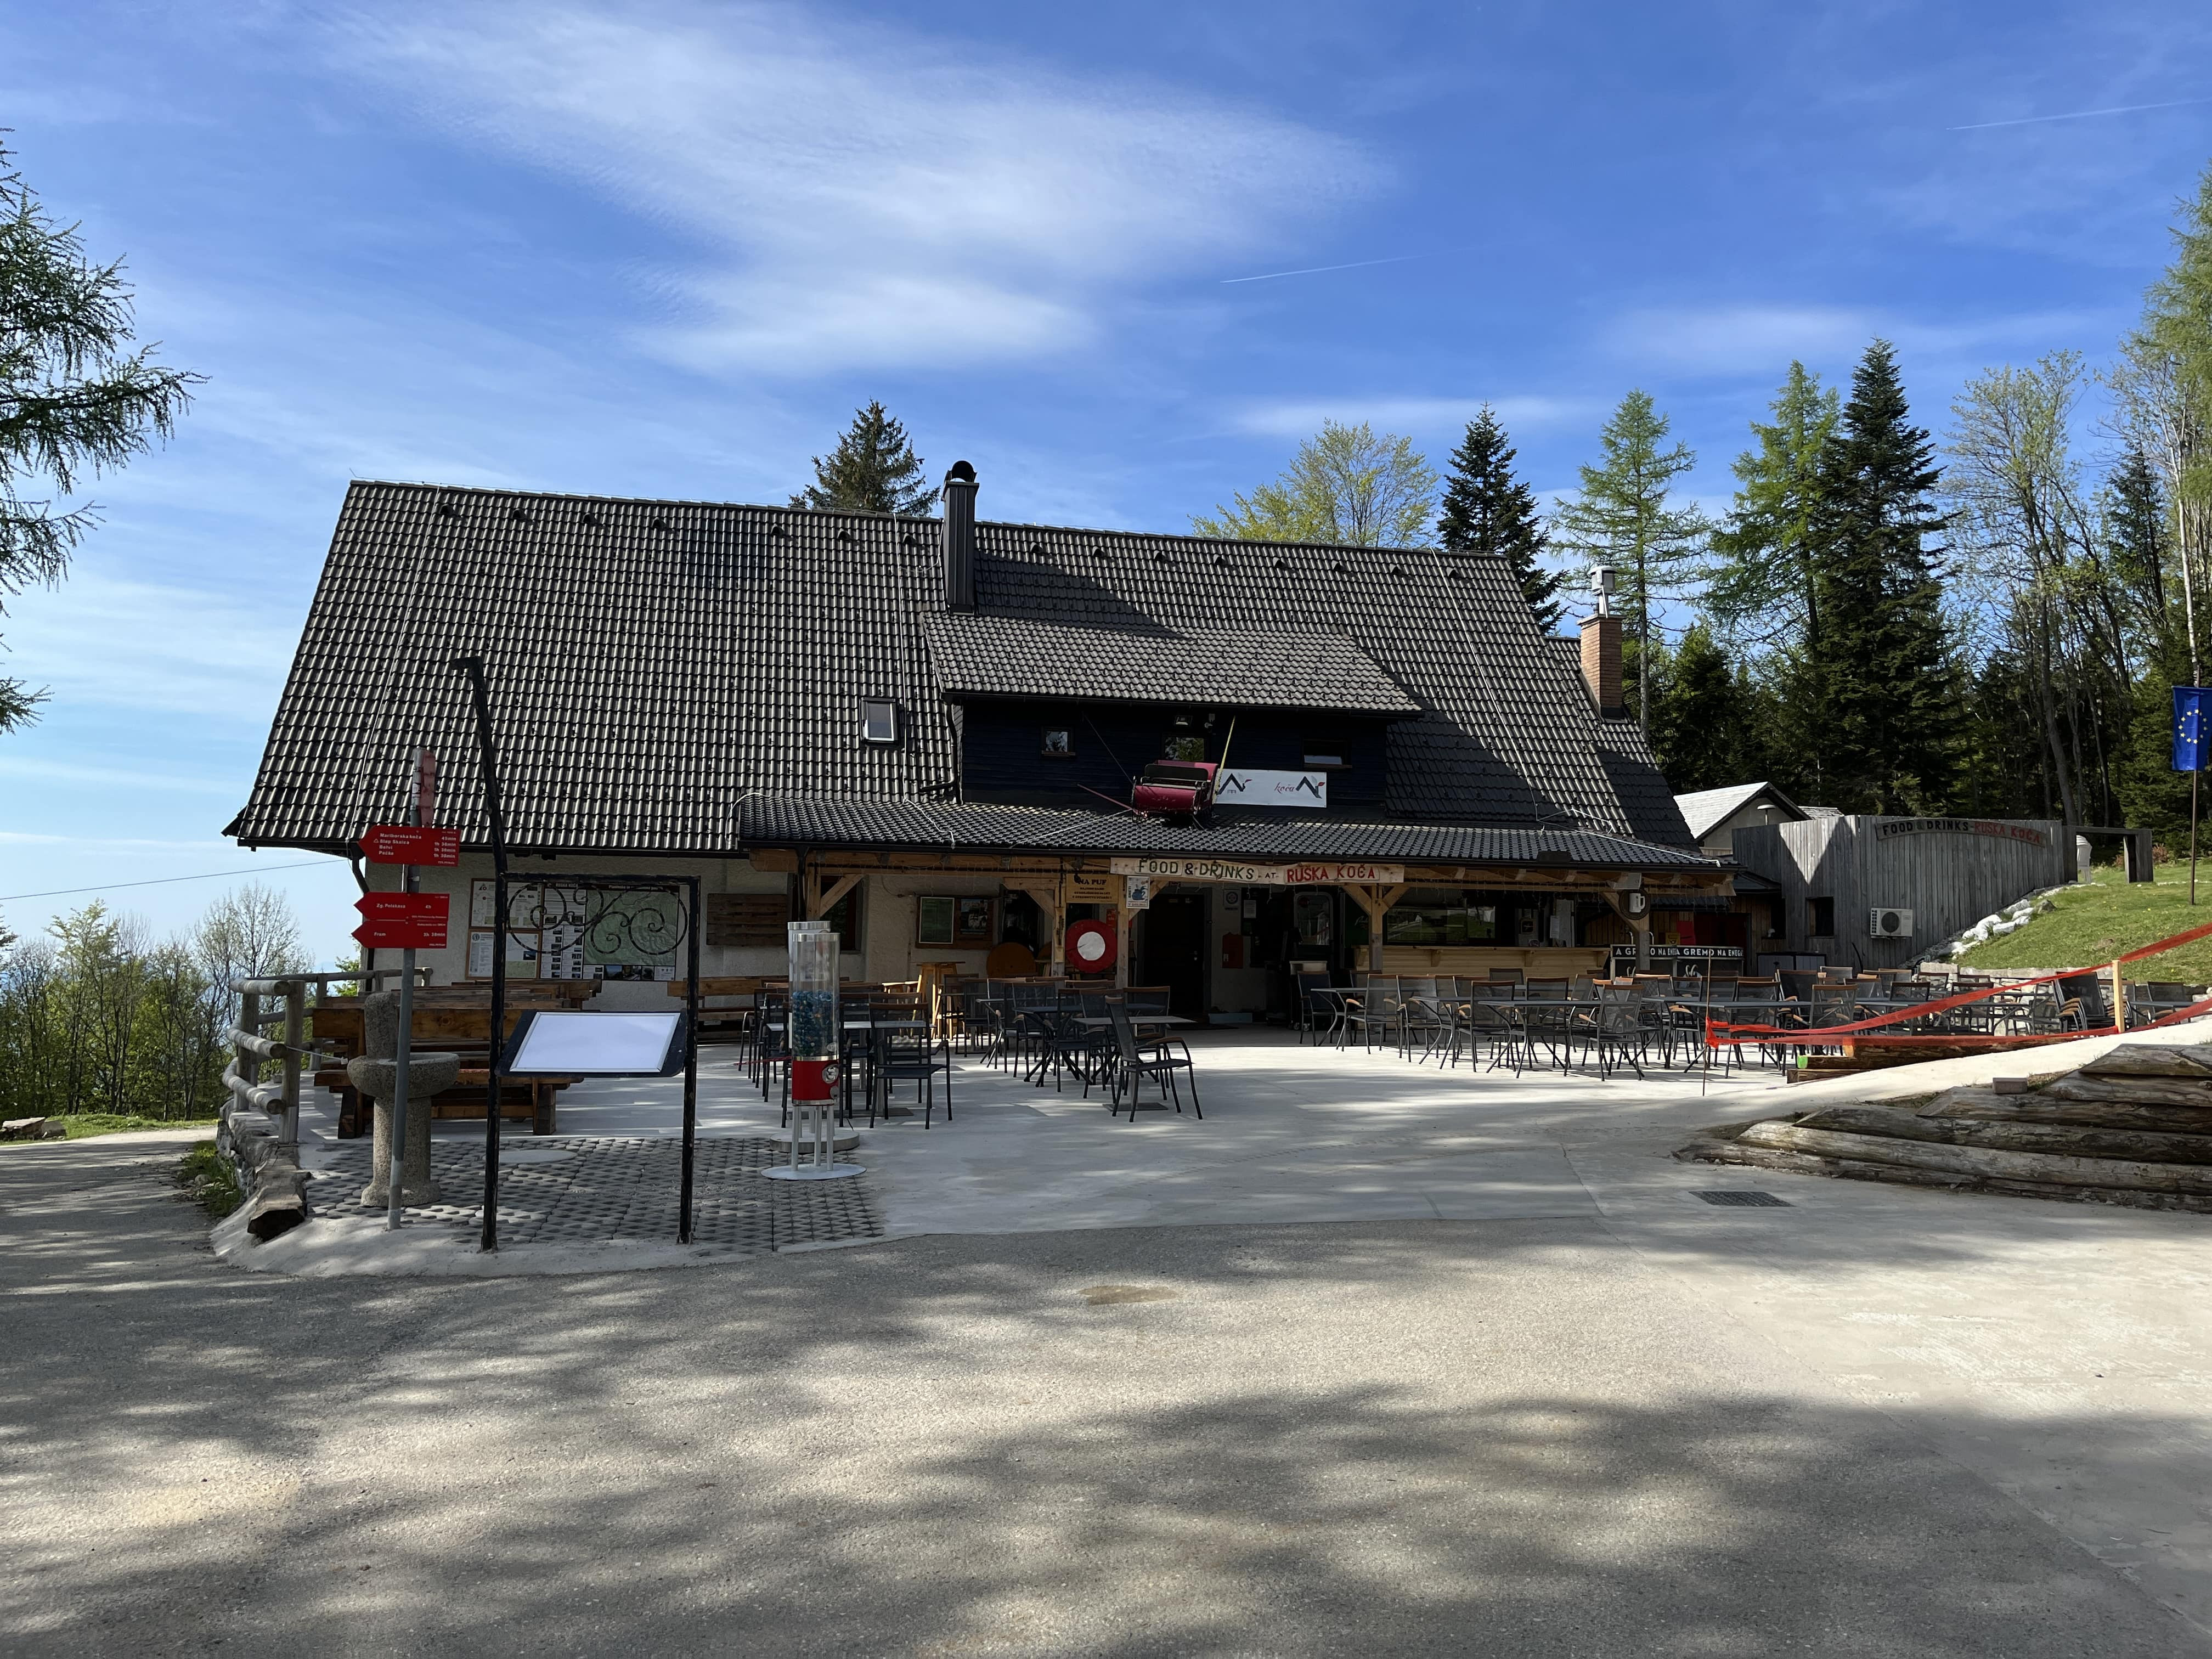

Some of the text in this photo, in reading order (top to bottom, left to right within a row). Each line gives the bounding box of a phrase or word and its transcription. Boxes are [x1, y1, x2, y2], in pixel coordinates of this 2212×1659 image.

[1274, 782, 1294, 794] koča
[1883, 822, 1913, 835] FOOD
[1927, 820, 1968, 831] DRINKS
[1139, 859, 1178, 874] FOOD
[1185, 862, 1194, 875] &
[1200, 862, 1254, 880] DRINKS
[1286, 865, 1329, 883] RUŠKA
[1337, 864, 1375, 879] KOČA
[1616, 947, 1622, 956] A
[1658, 947, 1666, 956] NA
[1683, 948, 1714, 956] GREMO
